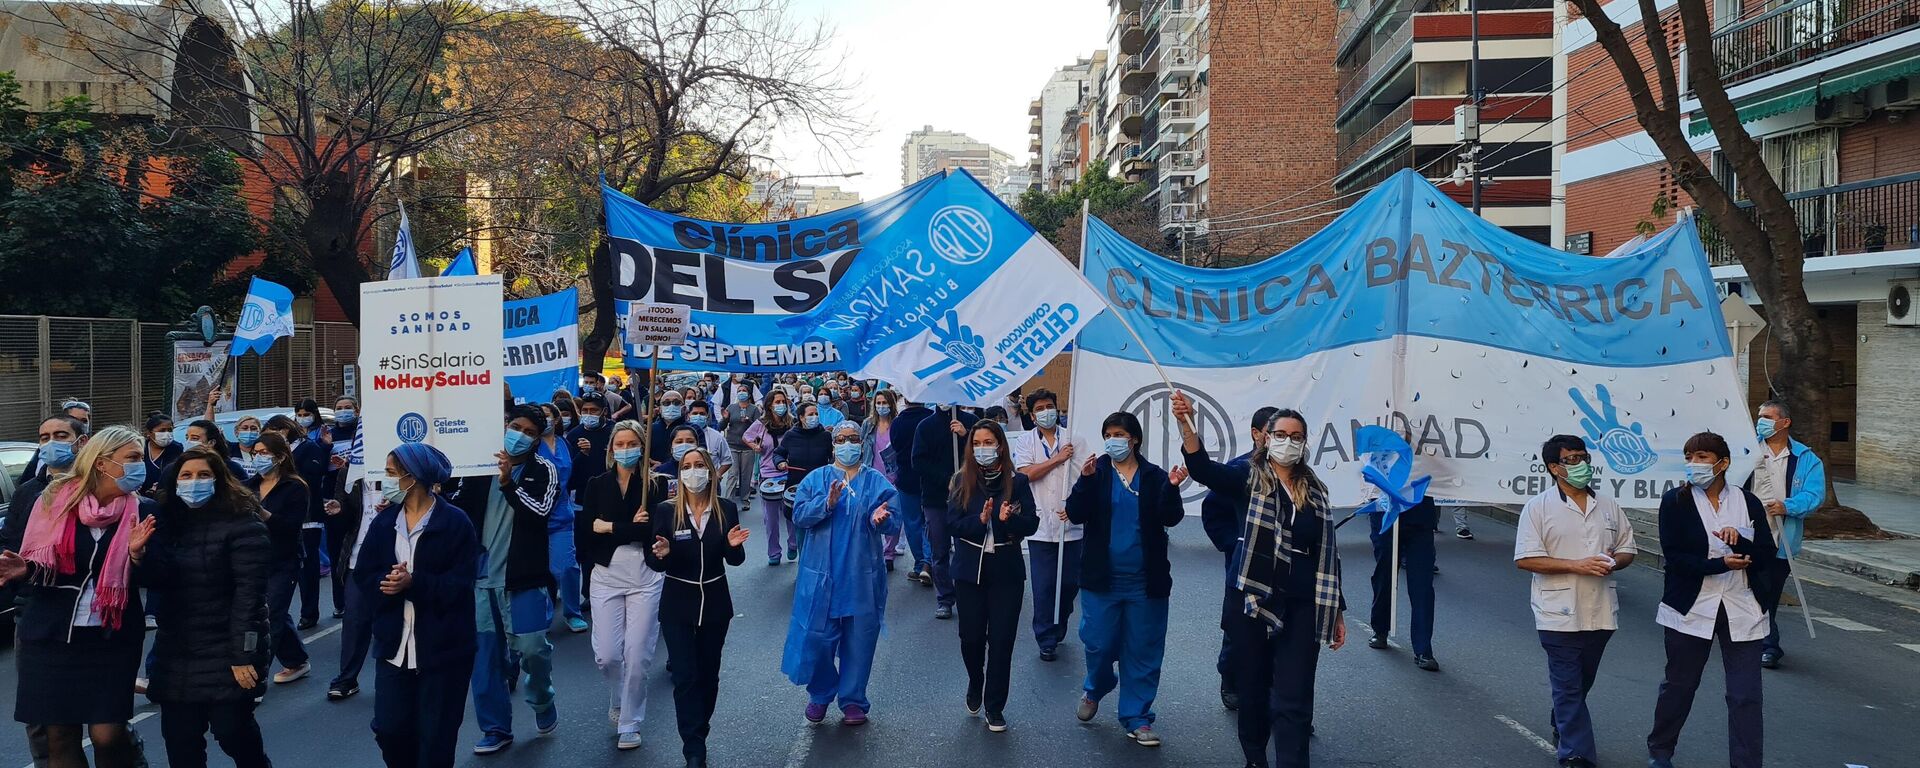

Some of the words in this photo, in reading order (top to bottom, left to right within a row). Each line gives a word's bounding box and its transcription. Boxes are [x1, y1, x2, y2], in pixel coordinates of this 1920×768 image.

[673, 219, 861, 261] Clínica
[610, 236, 754, 314] DEL
[1106, 262, 1338, 323] CLINICA
[399, 310, 461, 322] SOMOS
[638, 316, 682, 324] MERECEMOS
[390, 322, 470, 334] SANIDAD
[379, 352, 485, 370] #SinSalario
[373, 370, 491, 391] NoHaySalud
[433, 419, 466, 427] Celeste
[438, 426, 469, 435] Blanca
[1610, 479, 1625, 499] Y
[1634, 480, 1685, 499] BLA
